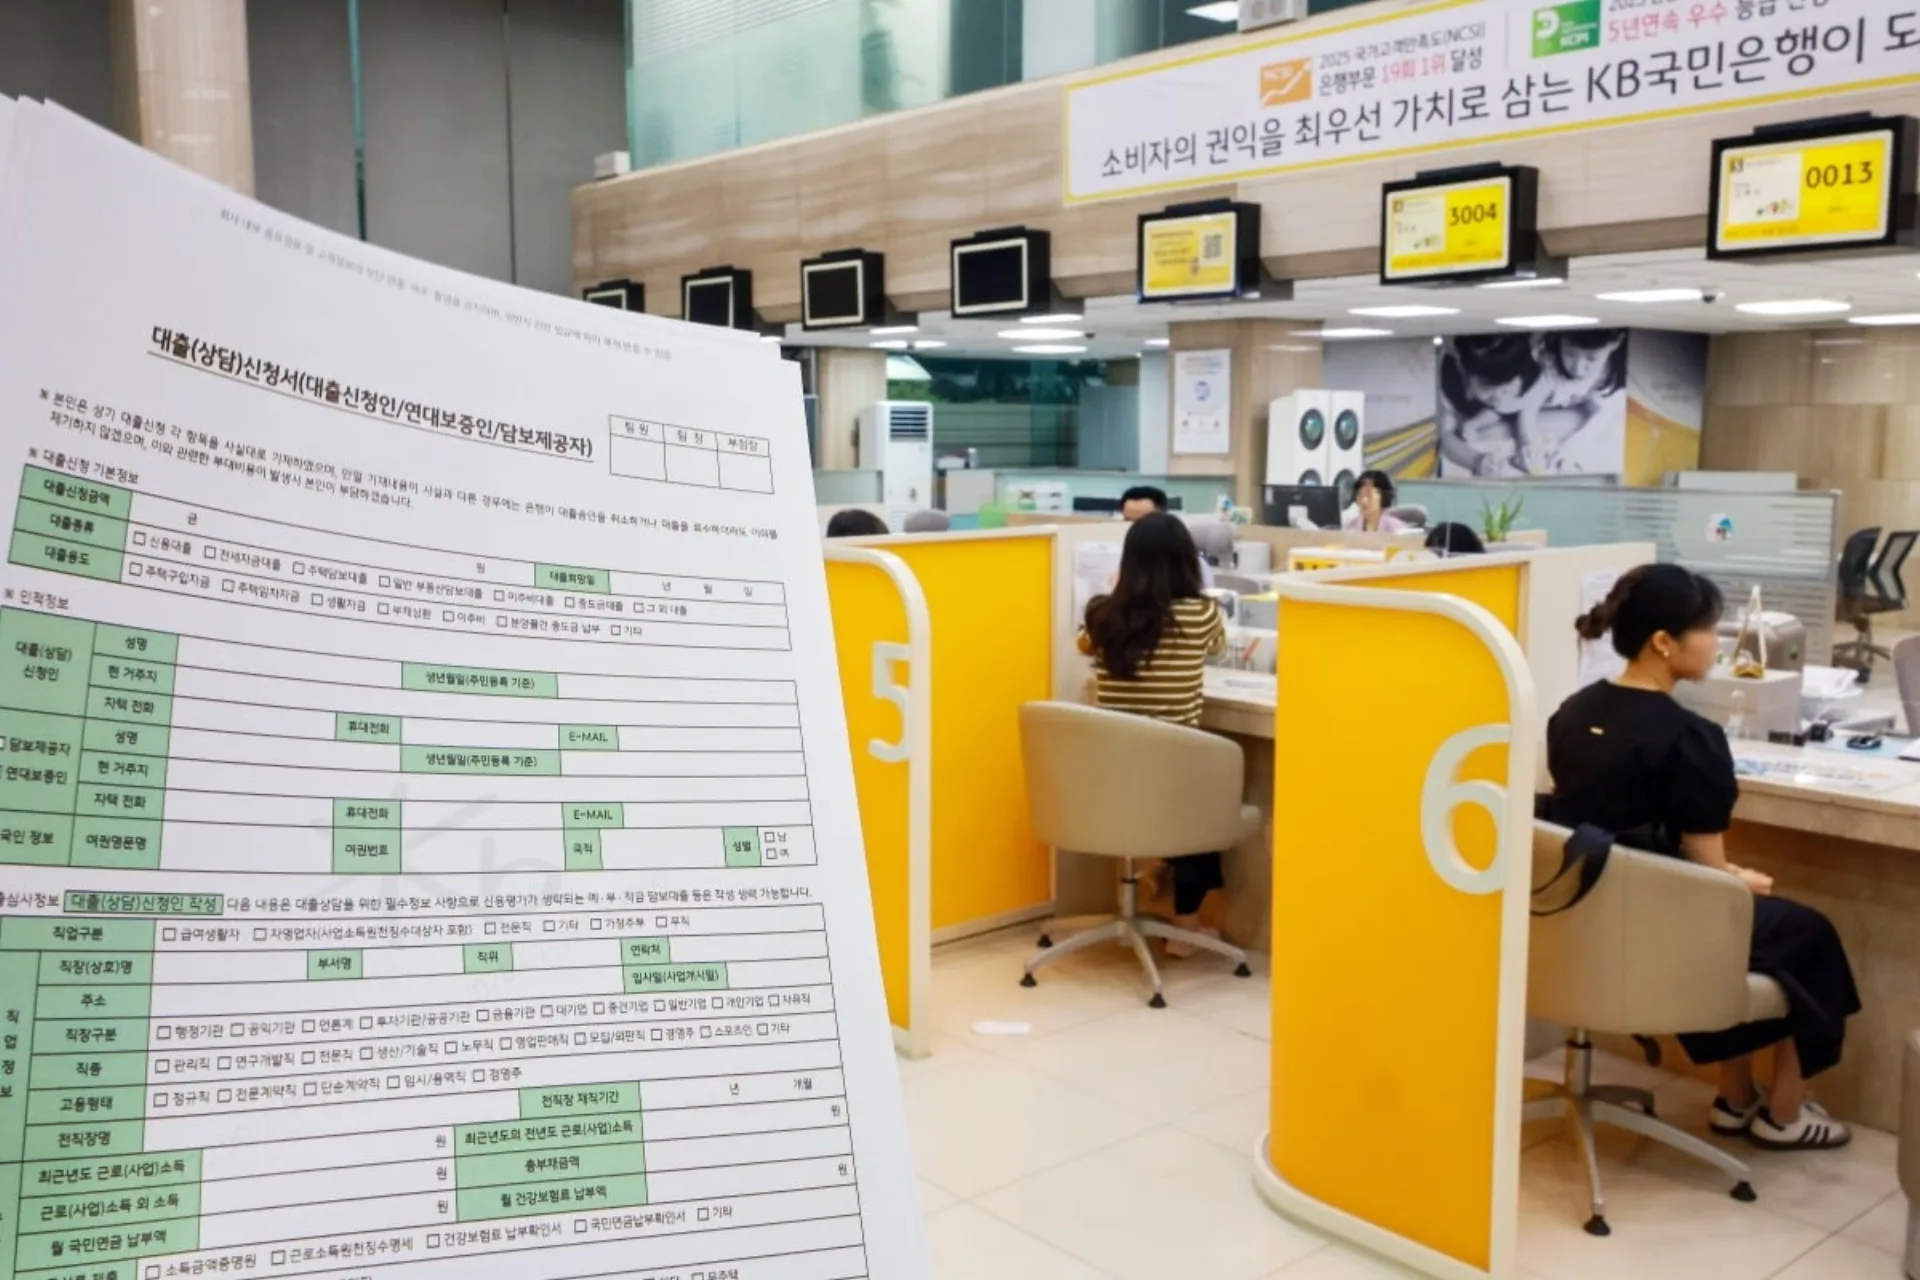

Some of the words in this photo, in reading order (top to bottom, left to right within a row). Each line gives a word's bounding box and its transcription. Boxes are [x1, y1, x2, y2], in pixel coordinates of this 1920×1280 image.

[1608, 10, 1679, 41] 5년연속
[1688, 3, 1727, 29] 우수
[1319, 65, 1376, 96] 은행부문
[1382, 59, 1416, 84] 19회
[1421, 53, 1447, 77] 1위
[1450, 47, 1483, 74] 달성
[1101, 132, 1197, 177] 소비자의
[1205, 117, 1286, 165] 권익을
[1294, 100, 1382, 146] 최우선
[1393, 85, 1490, 132] 가치로
[1501, 72, 1575, 119] 삼는
[1587, 17, 1865, 102] KB국민은행이
[1805, 160, 1874, 190] 0013
[1449, 201, 1498, 227] 3004
[150, 325, 594, 457] 대출(상담)신청서(대출신청인/연대보증인/담보제공자)
[93, 404, 116, 421] 상기
[120, 411, 166, 437] 대출신청
[224, 438, 267, 461] 사실대로
[43, 447, 91, 473] 대출신청
[94, 460, 140, 485] 기본정보
[44, 478, 112, 506] 대출신청금액
[50, 512, 95, 534] 대출종류
[149, 536, 193, 556] 신용대출
[220, 547, 282, 572] 전세자금대출
[20, 590, 70, 610] 인적정보
[44, 544, 91, 566] 대출용도
[145, 566, 211, 590] 주택구입자금
[327, 595, 366, 613] 생활자금
[624, 624, 643, 637] 기타
[15, 640, 73, 664] 대출(상담)
[125, 636, 148, 652] 성명
[511, 675, 536, 691] 기준)
[23, 665, 60, 682] 신청인
[108, 665, 120, 680] 현
[123, 667, 158, 684] 거주지
[104, 696, 128, 712] 자택
[132, 698, 155, 715] 전화
[348, 719, 390, 736] 휴대전화
[569, 731, 609, 743] E-MAIL
[868, 642, 910, 762] 5
[9, 736, 71, 757] 담보제공자
[115, 730, 139, 746] 성명
[426, 753, 510, 767] 생년월일(주민등록
[514, 755, 539, 768] 기준)
[6, 765, 68, 785] 연대보증인
[98, 760, 110, 775] 현
[113, 761, 149, 778] 거주지
[94, 792, 119, 807] 자택
[122, 794, 147, 809] 전화
[345, 805, 389, 821] 휴대전화
[573, 809, 614, 821] E-MAIL
[1420, 723, 1509, 896] 6
[29, 829, 55, 846] 정보
[86, 833, 147, 851] 여권영문명
[344, 843, 390, 857] 여권번호
[70, 893, 186, 912] 대출(상담)신청인
[189, 894, 218, 913] 작성
[226, 897, 251, 913] 다음
[254, 897, 292, 912] 내용은
[295, 897, 355, 913] 대출상담을
[359, 896, 382, 912] 위한
[385, 896, 432, 912] 필수정보
[435, 895, 480, 910] 사항으로
[483, 893, 539, 909] 신용평가가
[542, 892, 585, 907] 생략되는
[760, 886, 813, 900] 가능합니다.
[52, 926, 104, 941] 직업구분
[180, 927, 241, 942] 급여생활자
[447, 923, 473, 937] 포함)
[500, 921, 533, 935] 전문직
[558, 919, 580, 932] 기타
[59, 958, 134, 975] 직장(상호)명
[317, 956, 353, 971] 부서명
[477, 949, 500, 964] 직위
[629, 944, 661, 957] 연락처
[6, 1009, 20, 1025] 직
[80, 992, 107, 1007] 주소
[65, 1027, 118, 1044] 직장구분
[175, 1023, 224, 1040] 행정기관
[247, 1020, 296, 1038] 공익기관
[318, 1017, 355, 1033] 언론계
[376, 1009, 472, 1028] 투자기관/공공기관
[492, 1006, 536, 1021] 금융기관
[556, 1003, 588, 1017] 대기업
[668, 998, 708, 1011] 일반기업
[4, 1034, 18, 1050] 업
[76, 1060, 103, 1077] 직종
[174, 1056, 211, 1073] 관리직
[235, 1052, 296, 1070] 연구개발직
[319, 1048, 354, 1064] 전문직
[377, 1042, 440, 1060] 생산/기술직
[460, 1038, 494, 1053] 노무직
[770, 1022, 791, 1035] 기타
[57, 1130, 112, 1149] 전직장명
[541, 1093, 575, 1109] 전직장
[577, 1090, 620, 1106] 재직기간
[729, 1082, 740, 1096] 년
[793, 1077, 813, 1091] 개월
[59, 1095, 114, 1113] 고용형태
[173, 1090, 211, 1107] 정규직
[235, 1083, 298, 1102] 전문계약직
[320, 1077, 380, 1096] 단순계약직
[38, 1165, 93, 1185] 최근년도
[96, 1158, 186, 1182] 근로(사업)소득
[464, 1129, 521, 1146] 최근년도의
[524, 1125, 559, 1141] 전년도
[560, 1119, 634, 1138] 근로(사업)소득
[40, 1196, 133, 1222] 근로(사업)소득
[136, 1196, 150, 1212] 외
[153, 1192, 180, 1208] 소득
[436, 1166, 448, 1181] 원
[524, 1155, 581, 1173] 총부채금액
[51, 1240, 65, 1257] 월
[127, 1228, 168, 1249] 납부액
[437, 1199, 449, 1214] 원
[501, 1192, 512, 1208] 월
[515, 1188, 571, 1206] 건강보험료
[573, 1184, 608, 1201] 납부액
[837, 1162, 848, 1177] 원
[165, 1253, 257, 1277] 소득금액증명원
[443, 1228, 503, 1247] 건강보험료
[504, 1222, 563, 1242] 납부확인서
[712, 1205, 734, 1219] 기타
